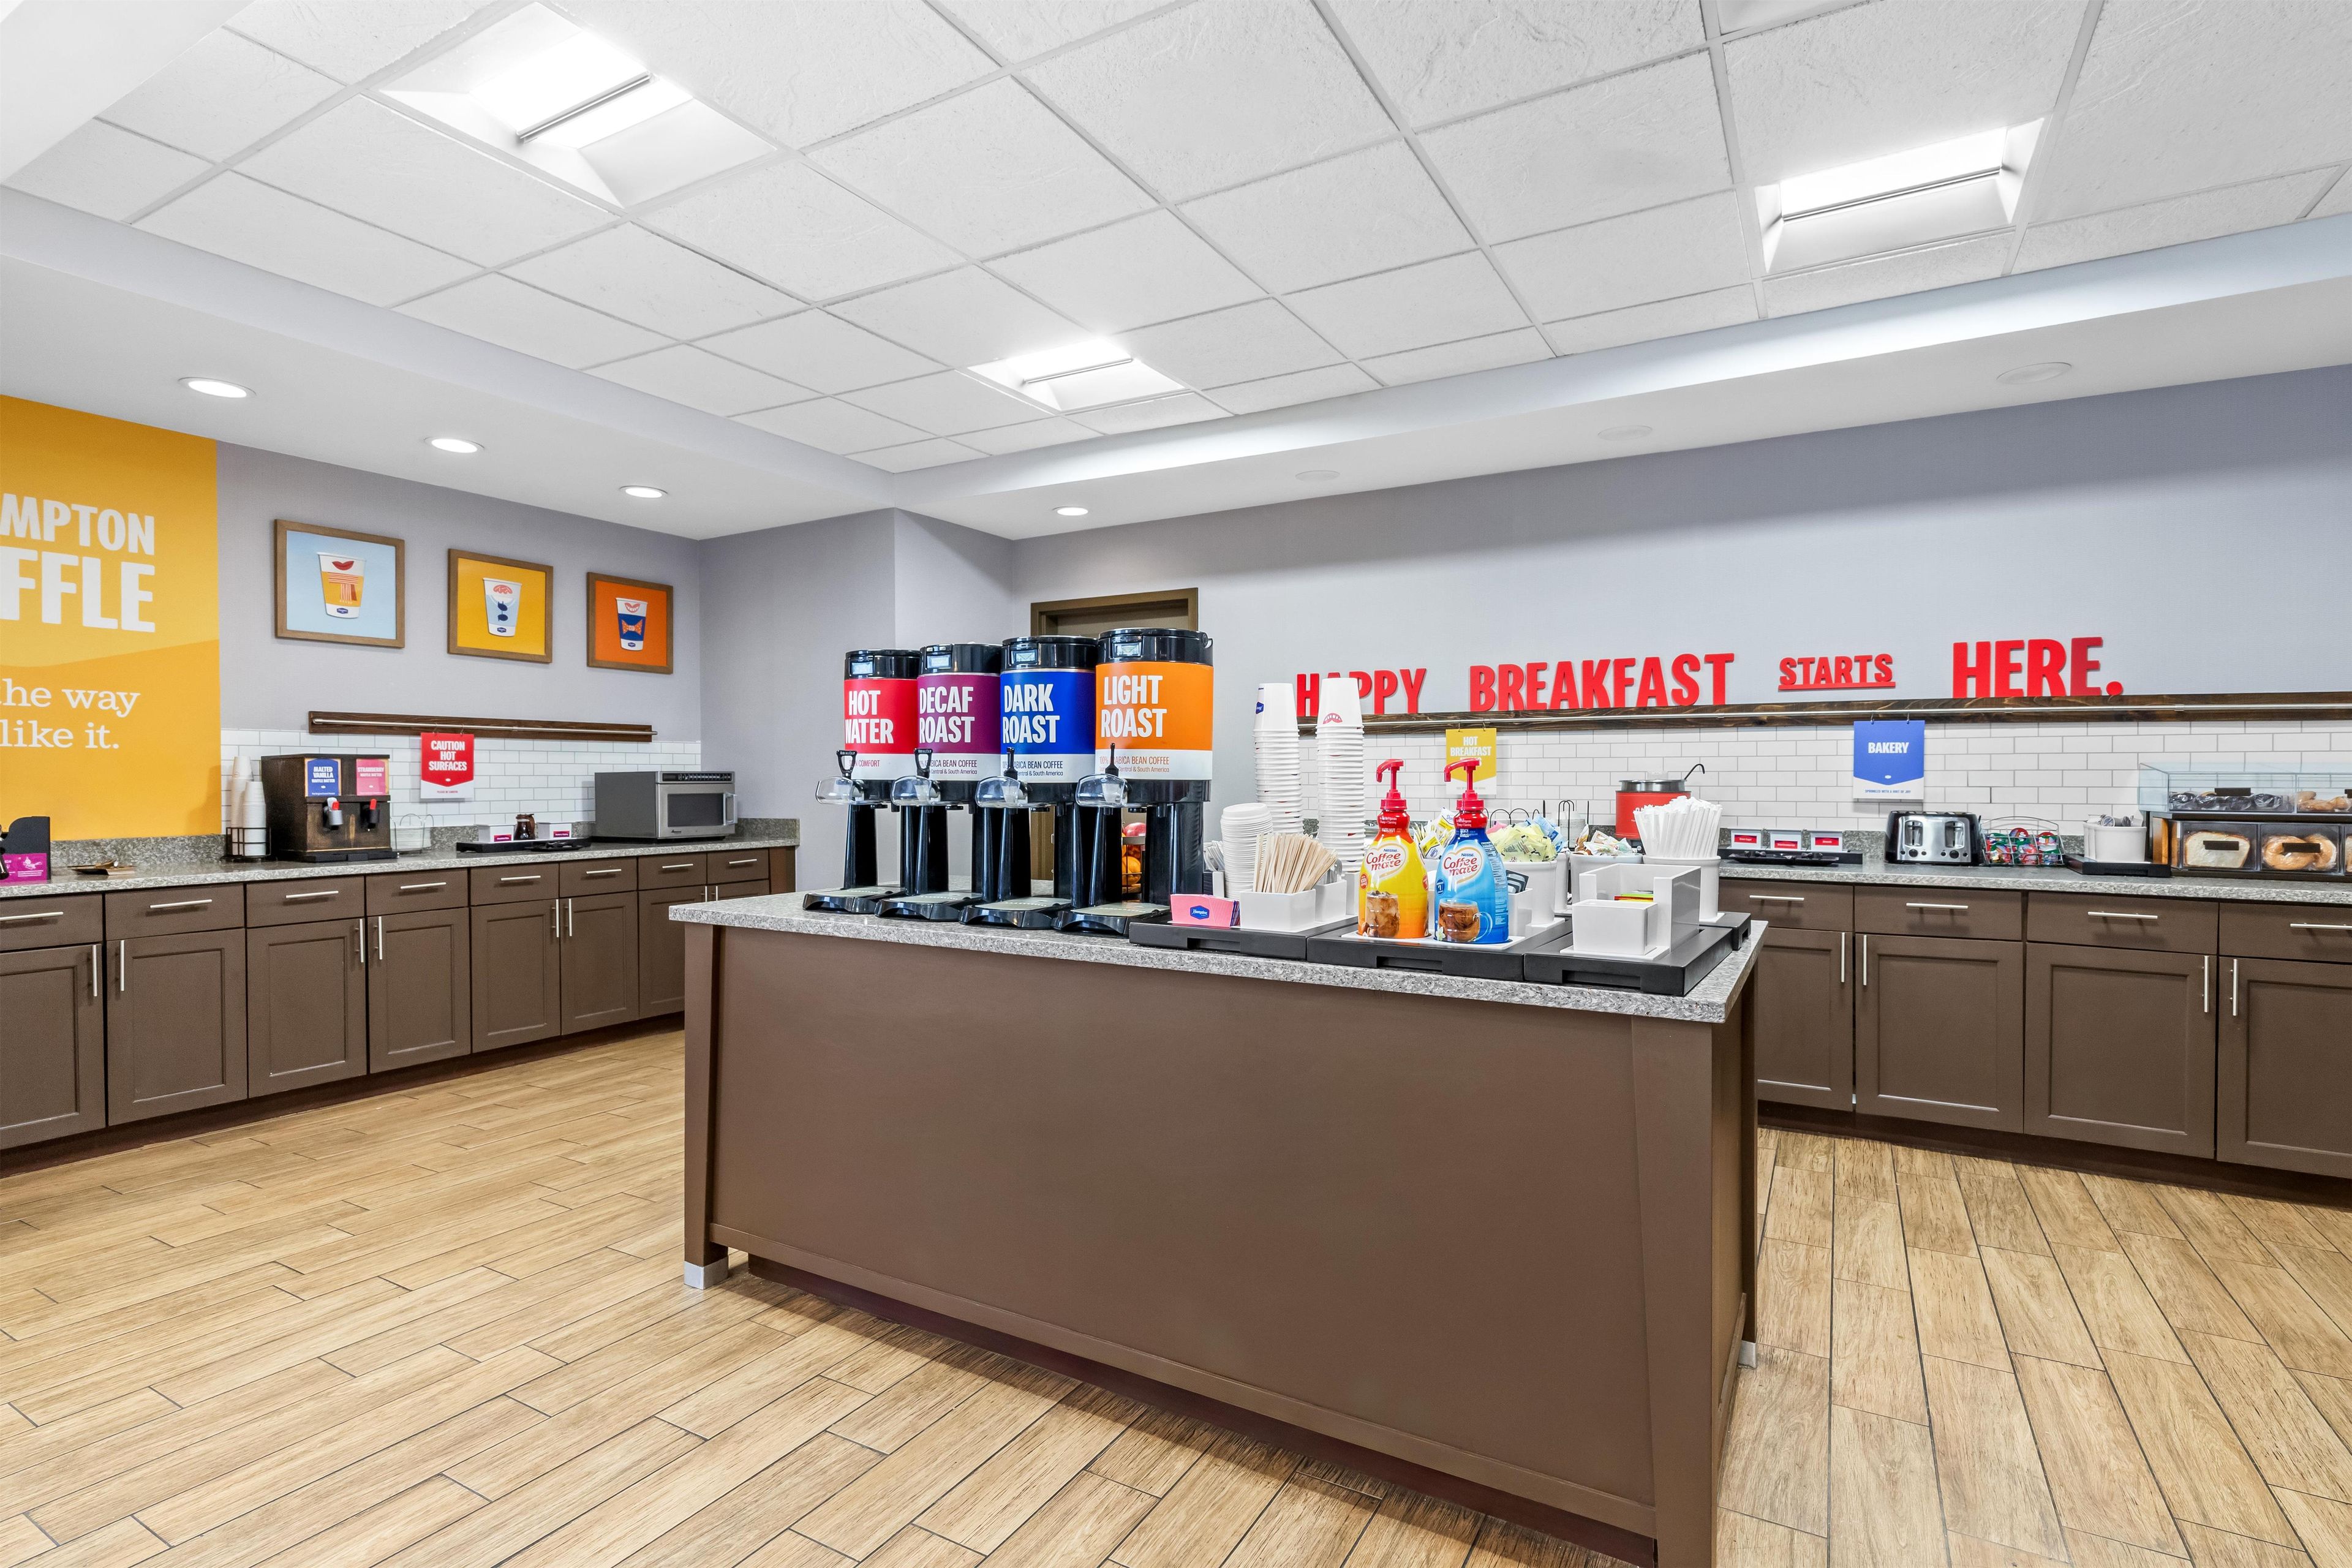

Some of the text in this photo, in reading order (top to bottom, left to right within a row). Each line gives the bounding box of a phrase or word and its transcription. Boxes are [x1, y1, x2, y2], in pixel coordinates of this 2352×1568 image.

[1297, 636, 2123, 716] HPPY BREAKFAST STARTS HERE.
[1004, 684, 1054, 712] DARK
[1104, 675, 1163, 705] LIGHT
[62, 688, 141, 718] way
[848, 690, 881, 715] HOT
[919, 686, 974, 714] DECAF
[845, 718, 894, 744] WATER
[919, 716, 975, 744] ROAST
[1003, 715, 1060, 744] ROAST
[1101, 708, 1167, 737] ROAST
[0, 718, 119, 749] like it.
[1463, 736, 1478, 745] HOT
[431, 740, 466, 751] CAUTION
[1450, 746, 1492, 756] BREAKFAST
[1868, 742, 1909, 753] BAKERY
[440, 751, 456, 761] HOT
[1148, 756, 1169, 765] COFFEE
[429, 761, 467, 771] SURFACES
[1366, 852, 1401, 864] Coffee
[1371, 859, 1401, 871] mate
[1444, 857, 1477, 869] Coffee
[1449, 864, 1477, 876] mate
